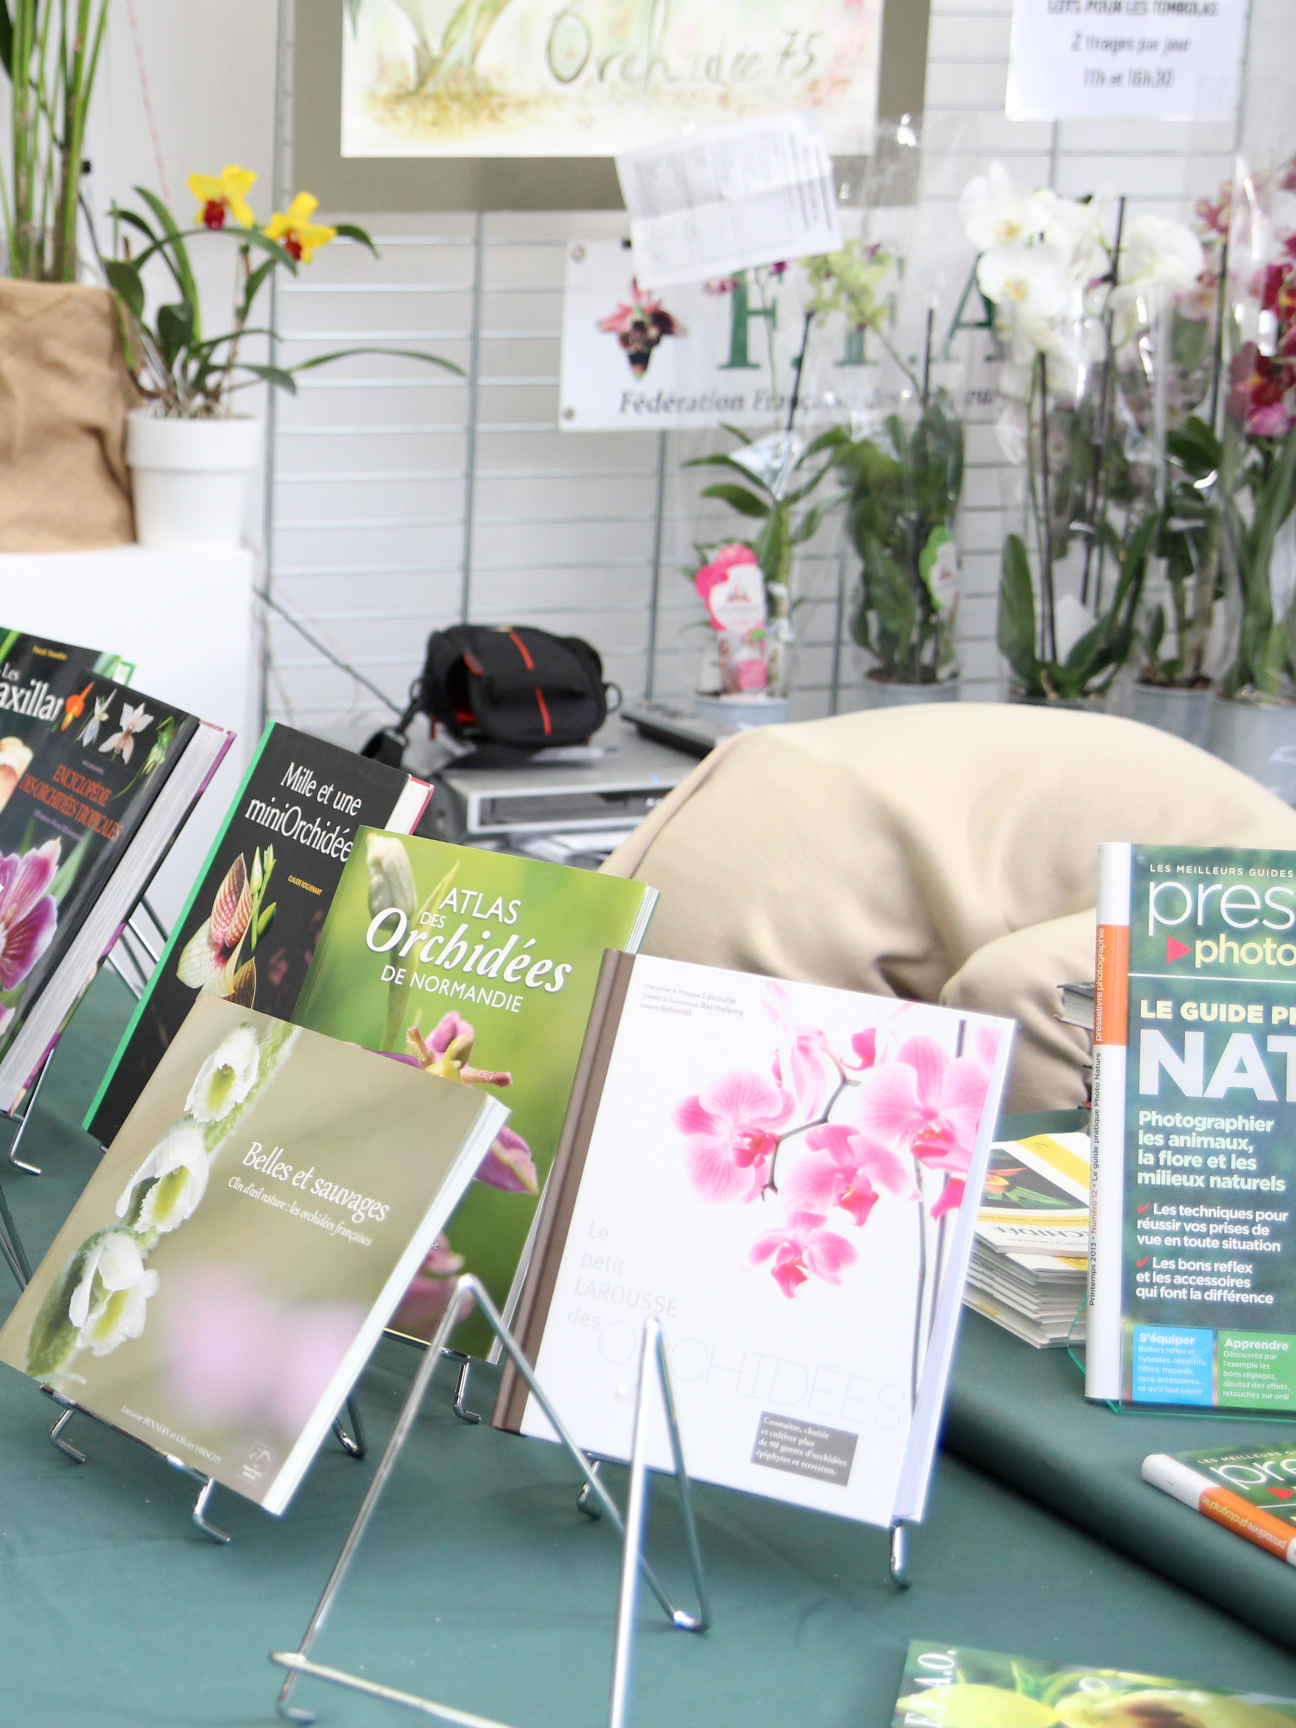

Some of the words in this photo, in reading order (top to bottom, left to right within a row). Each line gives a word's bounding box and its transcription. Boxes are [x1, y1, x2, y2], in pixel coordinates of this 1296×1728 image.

[1086, 37, 1134, 56] tirages
[1163, 38, 1193, 57] jour
[619, 389, 744, 416] Fédération
[1, 662, 20, 681] Les
[52, 764, 112, 807] ENCYCLOPÉDIE
[280, 761, 317, 797] Mille
[316, 784, 334, 805] et
[333, 793, 362, 816] une
[19, 774, 38, 794] DES
[33, 782, 79, 817] ORCHIDÉES
[74, 803, 124, 841] TROPICALES
[244, 796, 354, 862] miniOrchidée
[1150, 864, 1171, 873] LES
[1176, 865, 1243, 876] MEILLEURS
[1249, 869, 1294, 878] GUIDES
[439, 887, 522, 925] ATLAS
[1148, 881, 1296, 936] pres
[419, 911, 446, 929] DES
[365, 907, 573, 993] Orchidées
[1097, 928, 1105, 991] photographie
[1195, 933, 1296, 968] photo
[380, 964, 407, 985] DE
[410, 972, 524, 1013] NORMANDIE
[660, 1004, 692, 1017] Schmidt
[1095, 991, 1103, 1042] presselivre
[1140, 1000, 1173, 1019] LE
[1180, 1001, 1264, 1023] GUIDE
[1138, 1028, 1296, 1103] NAT
[1138, 1110, 1275, 1133] Photographier
[1138, 1130, 1165, 1146] les
[1168, 1132, 1254, 1153] animaux,
[1092, 1145, 1100, 1170] guide
[1137, 1149, 1154, 1165] la
[1158, 1150, 1203, 1167] flore
[1206, 1154, 1227, 1169] et
[1230, 1154, 1257, 1170] les
[242, 1141, 292, 1181] Belles
[291, 1166, 315, 1190] et
[310, 1178, 389, 1223] sauvages
[1091, 1172, 1098, 1181] Le
[1137, 1170, 1205, 1188] milieux
[1209, 1174, 1286, 1192] naturels
[1091, 1189, 1098, 1200] 12
[228, 1176, 245, 1192] Clin
[261, 1191, 286, 1210] nature
[288, 1201, 300, 1216] les
[299, 1210, 335, 1231] orchidées
[330, 1221, 373, 1246] françaises
[1090, 1201, 1098, 1234] Numéro
[1153, 1203, 1177, 1216] Les
[1178, 1205, 1253, 1220] techniques
[1255, 1210, 1289, 1223] pour
[588, 1221, 609, 1241] Le
[1136, 1217, 1181, 1231] réussir
[1183, 1222, 1207, 1233] vos
[1209, 1222, 1250, 1236] prises
[1251, 1224, 1270, 1236] de
[1090, 1242, 1098, 1262] 2013
[1136, 1235, 1162, 1246] vue
[1164, 1236, 1181, 1247] en
[1183, 1235, 1220, 1249] toute
[1221, 1237, 1281, 1252] situation
[580, 1253, 625, 1275] petit
[1152, 1257, 1176, 1270] Les
[1177, 1258, 1212, 1272] bons
[1213, 1260, 1253, 1274] reflex
[1089, 1264, 1097, 1306] Printemps
[1135, 1271, 1151, 1283] et
[1152, 1271, 1172, 1284] les
[1173, 1275, 1251, 1288] accessoires
[575, 1277, 679, 1317] LAROUSSE
[1135, 1286, 1158, 1299] qui
[1159, 1286, 1188, 1299] font
[1189, 1288, 1202, 1300] la
[1204, 1288, 1274, 1304] différence
[568, 1306, 600, 1329] des
[1139, 1332, 1196, 1346] S'équiper
[1224, 1338, 1289, 1351] Apprendre
[1138, 1355, 1172, 1365] hybrides,
[1165, 1347, 1186, 1355] reflex
[1187, 1348, 1195, 1356] et
[1223, 1350, 1264, 1360] Découvrez
[1264, 1353, 1277, 1361] par
[1138, 1365, 1161, 1374] filtres,
[1162, 1367, 1195, 1376] trépieds,
[1223, 1360, 1258, 1370] l'exemple
[1259, 1362, 1270, 1370] les
[1138, 1376, 1156, 1384] sacs,
[1223, 1370, 1242, 1378] bons
[1242, 1371, 1277, 1382] réglages,
[1223, 1380, 1251, 1390] ajoutez
[1251, 1381, 1265, 1389] des
[1266, 1382, 1290, 1391] effets,
[1147, 1385, 1164, 1394] qu'il
[1164, 1386, 1179, 1394] faut
[1180, 1388, 1203, 1396] savoir
[1223, 1390, 1260, 1399] retouchez
[1261, 1392, 1273, 1400] sur
[120, 1405, 143, 1423] Lorraine
[142, 1416, 170, 1437] BENNERY
[169, 1432, 177, 1440] et
[175, 1434, 196, 1450] Olivier
[804, 1426, 830, 1439] choisir
[769, 1431, 797, 1442] cultiver
[797, 1438, 815, 1448] plus
[756, 1449, 791, 1464] épiphytes
[800, 1461, 836, 1475] terrestres.
[758, 1438, 767, 1446] de
[769, 1441, 779, 1449] 90
[779, 1445, 804, 1456] genres
[805, 1450, 847, 1467] d'orchidées
[1220, 1451, 1282, 1462] MEILLEURS
[1208, 1458, 1296, 1490] pre
[1201, 1495, 1249, 1528] photographie
[1247, 1522, 1288, 1549] presselivre
